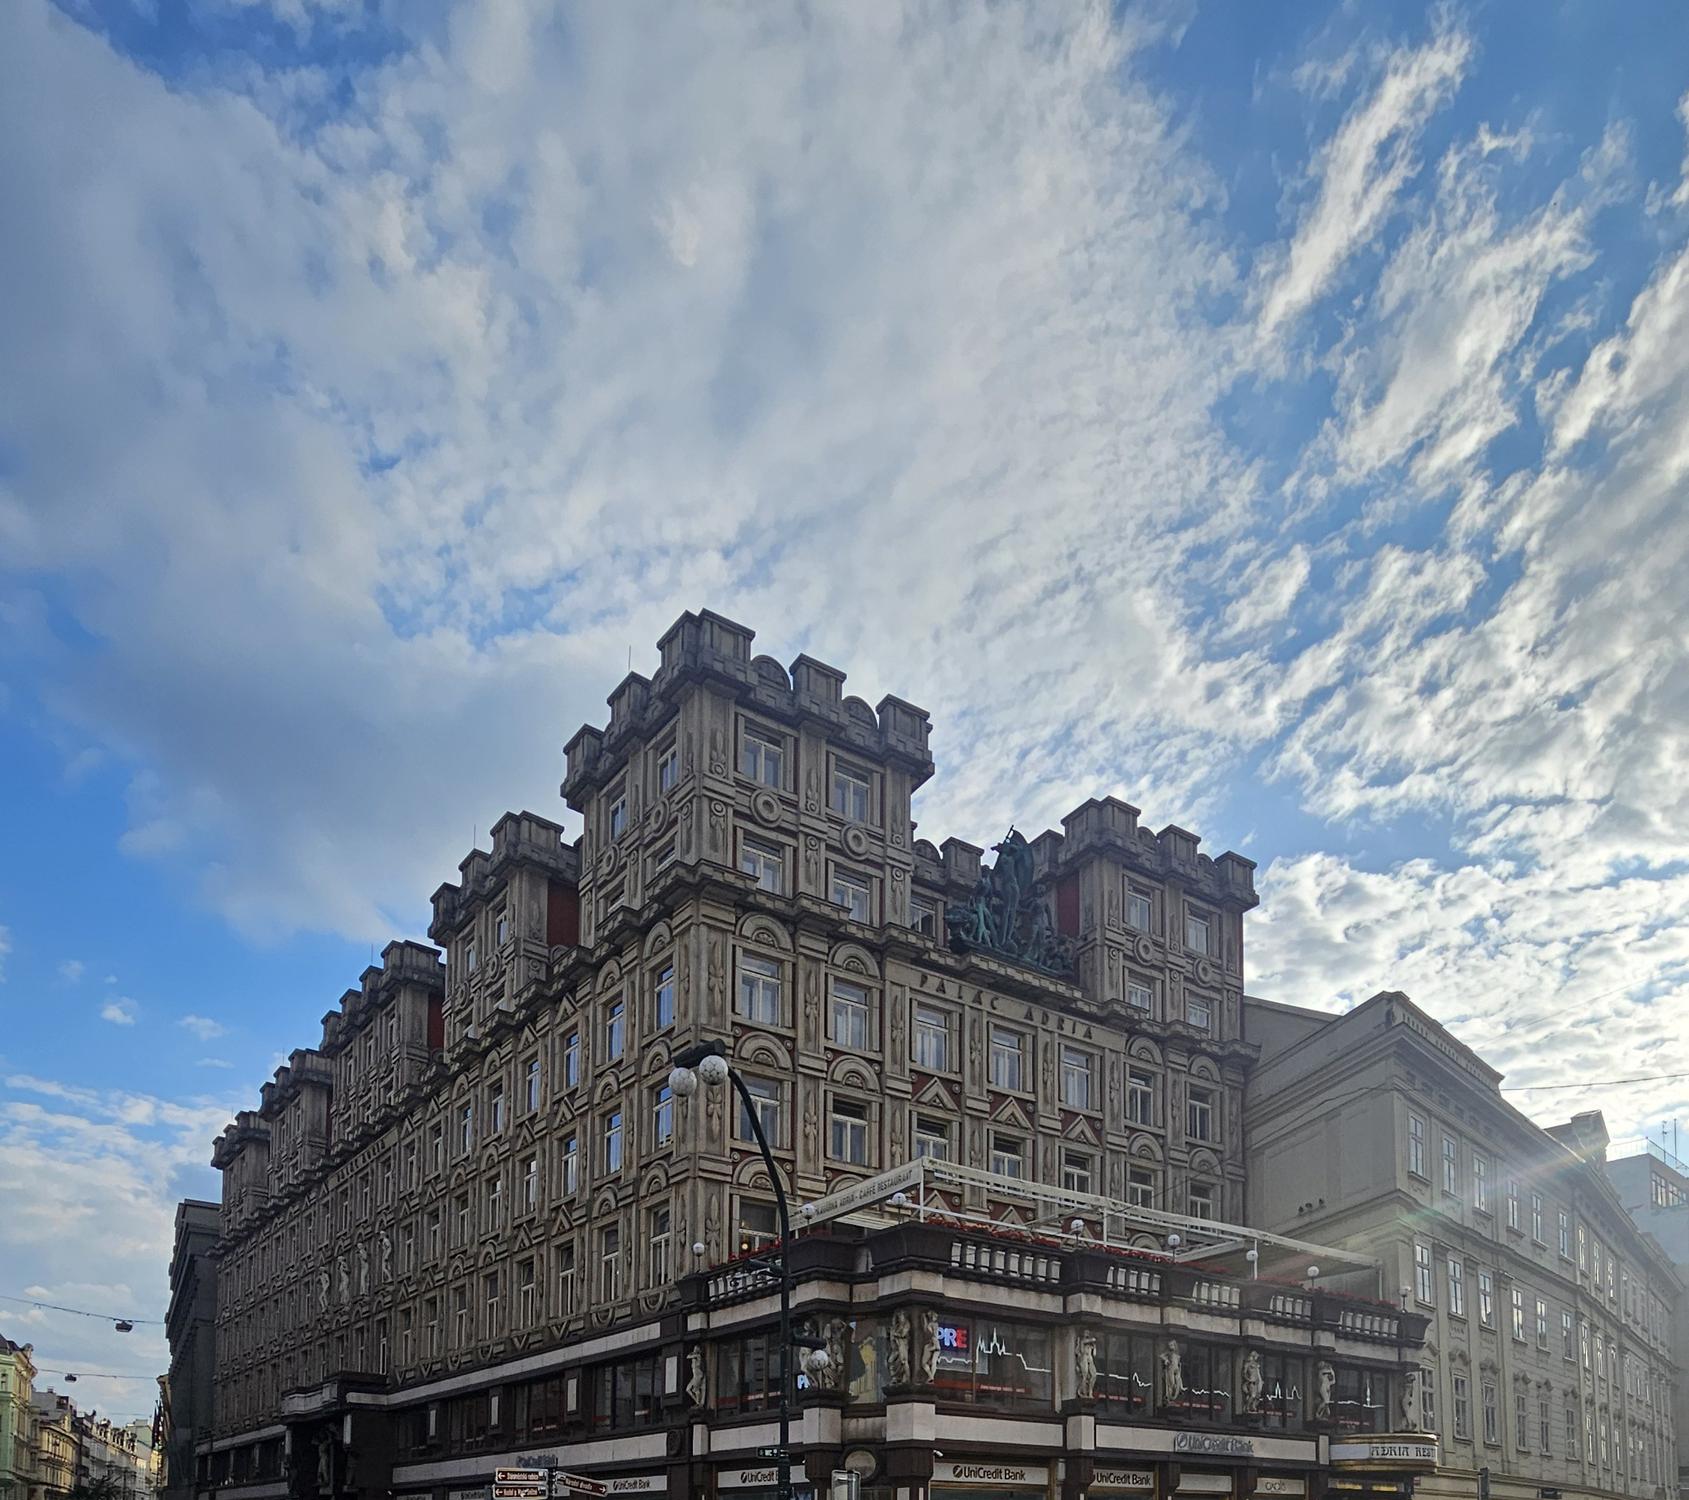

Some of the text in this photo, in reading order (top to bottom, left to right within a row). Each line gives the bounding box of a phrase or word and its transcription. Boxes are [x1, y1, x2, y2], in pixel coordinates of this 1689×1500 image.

[936, 1327, 968, 1349] PRE
[1370, 1446, 1410, 1457] ADRIA
[747, 1470, 776, 1483] UniCredit
[963, 1466, 1026, 1481] UniCredit Bank
[1096, 1472, 1151, 1485] UniCredit Bank
